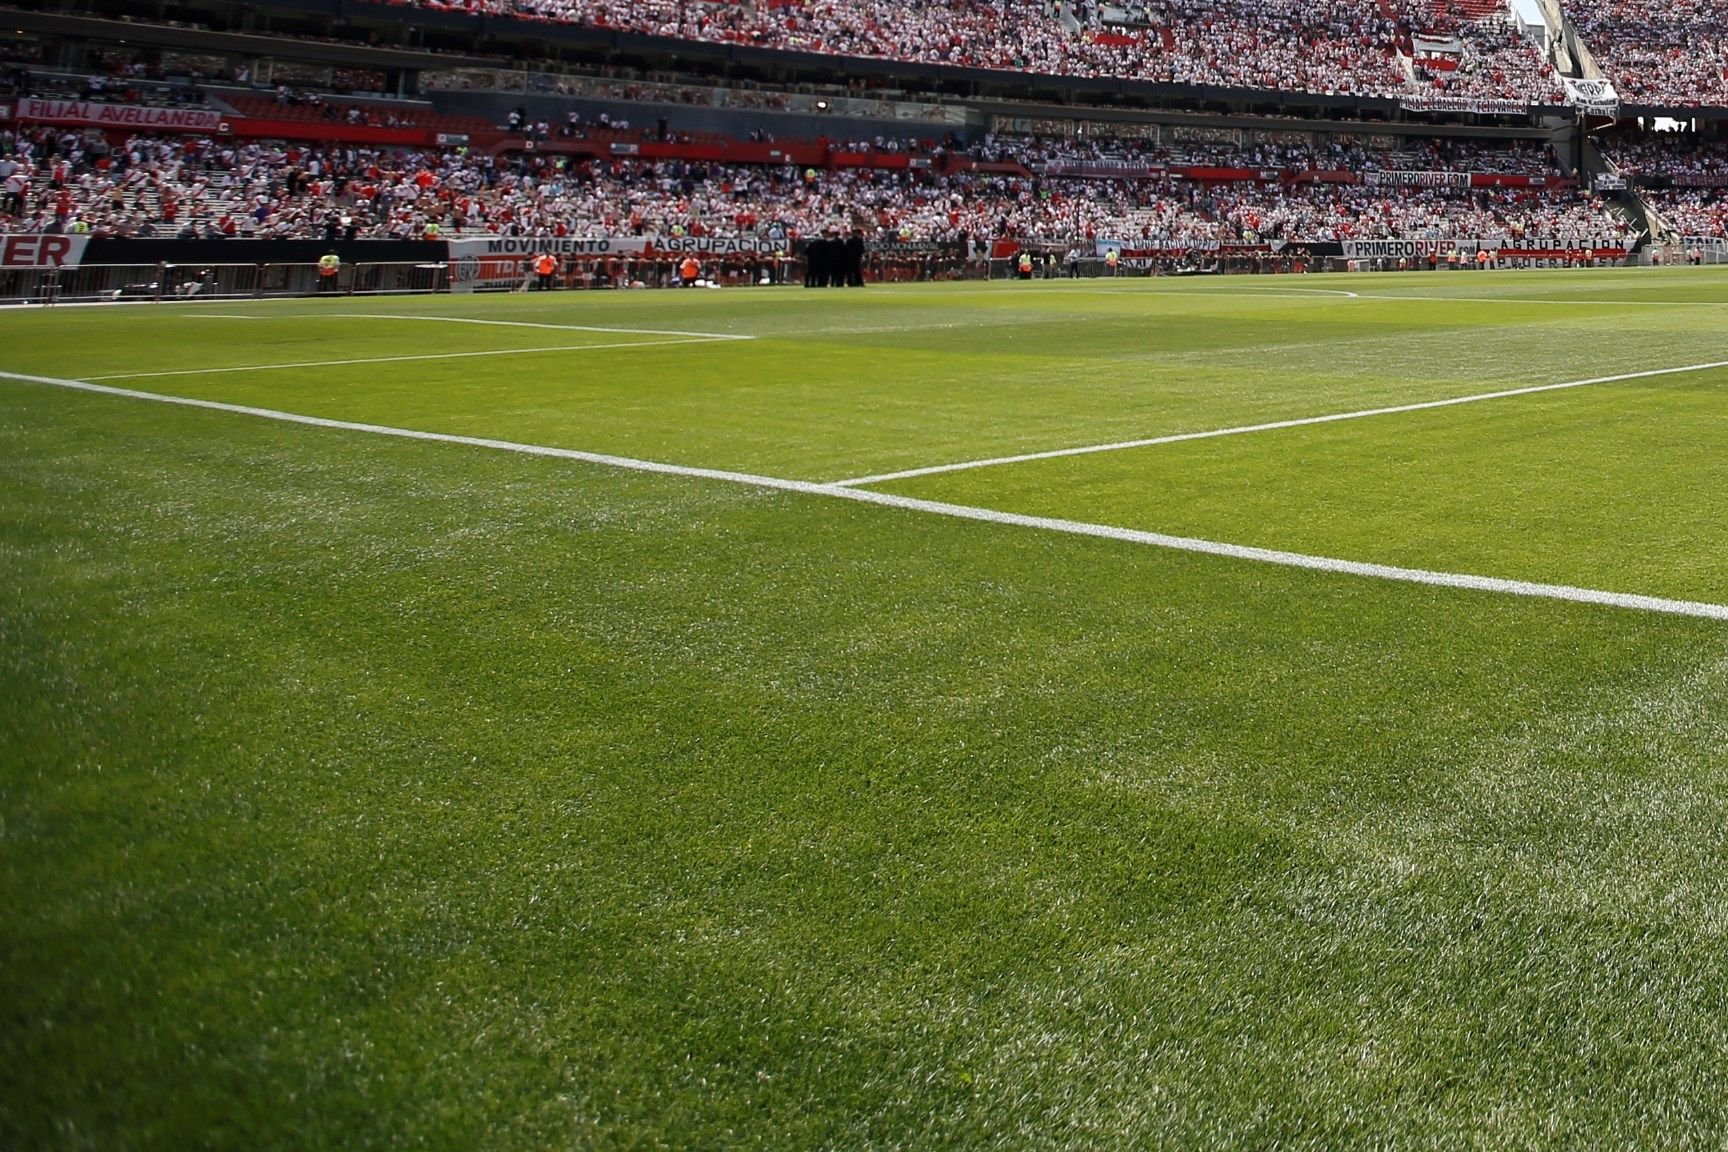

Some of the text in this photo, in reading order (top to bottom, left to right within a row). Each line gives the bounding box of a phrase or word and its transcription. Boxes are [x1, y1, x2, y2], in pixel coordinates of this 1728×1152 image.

[29, 101, 89, 119] FILIAL
[0, 236, 70, 266] ER
[488, 239, 611, 253] MOVIMIENTO
[654, 236, 788, 253] AGRUPACION
[1501, 239, 1624, 250] AGRUPACION
